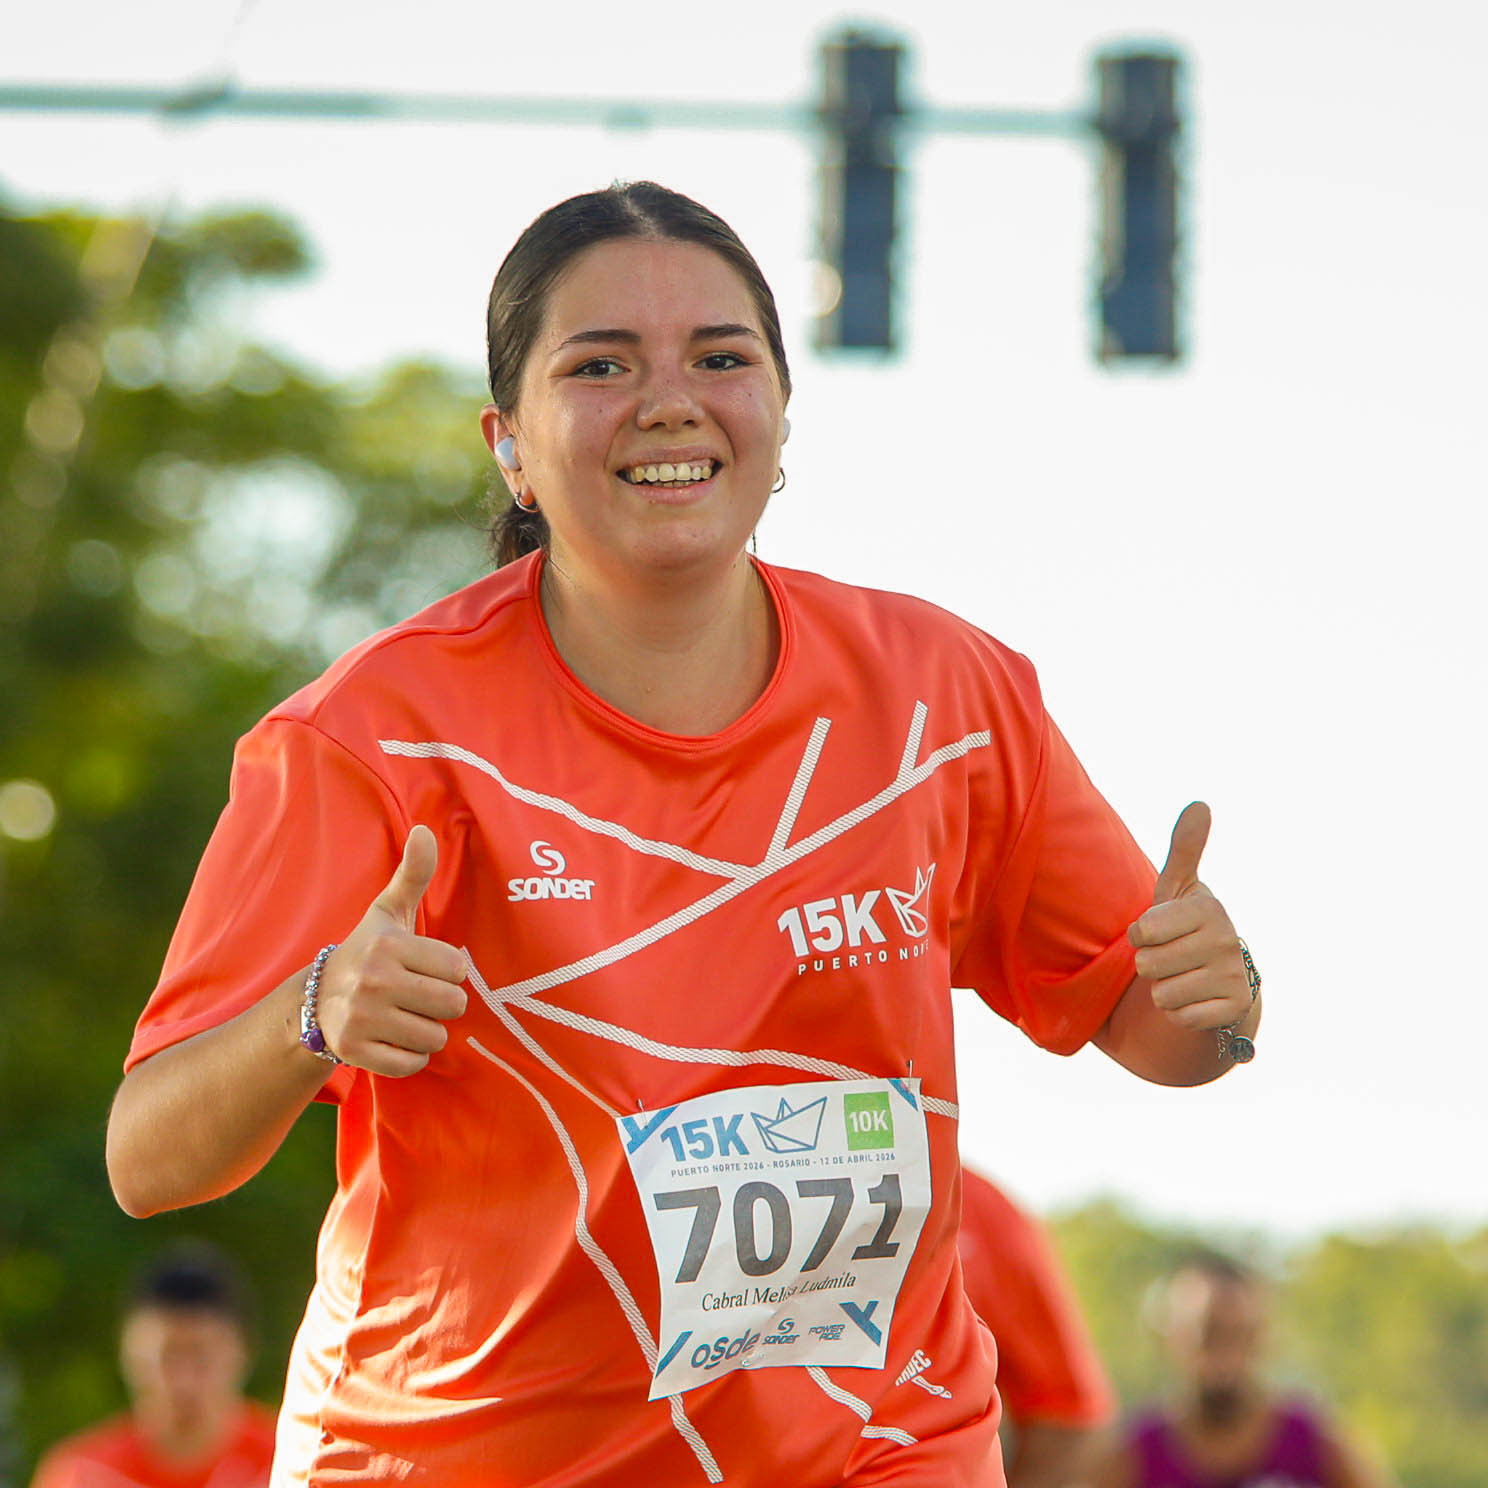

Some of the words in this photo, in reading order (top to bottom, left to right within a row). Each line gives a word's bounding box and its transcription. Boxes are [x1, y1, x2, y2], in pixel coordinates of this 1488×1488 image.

[777, 890, 888, 958] 15K
[798, 949, 888, 976] PUERTO
[661, 1113, 750, 1162] 15K
[849, 1109, 889, 1133] 10K
[671, 1165, 709, 1177] PUERTO
[713, 1162, 741, 1173] NORTE
[743, 1161, 765, 1171] 2026
[773, 1158, 811, 1169] ROSARIO
[820, 1157, 830, 1166] 12
[832, 1155, 844, 1164] DE
[847, 1154, 873, 1163] ABRIL
[875, 1153, 896, 1162] 2026
[653, 1174, 903, 1284] 7071
[702, 1288, 748, 1312] Cabral
[800, 1272, 857, 1294] Ludmila
